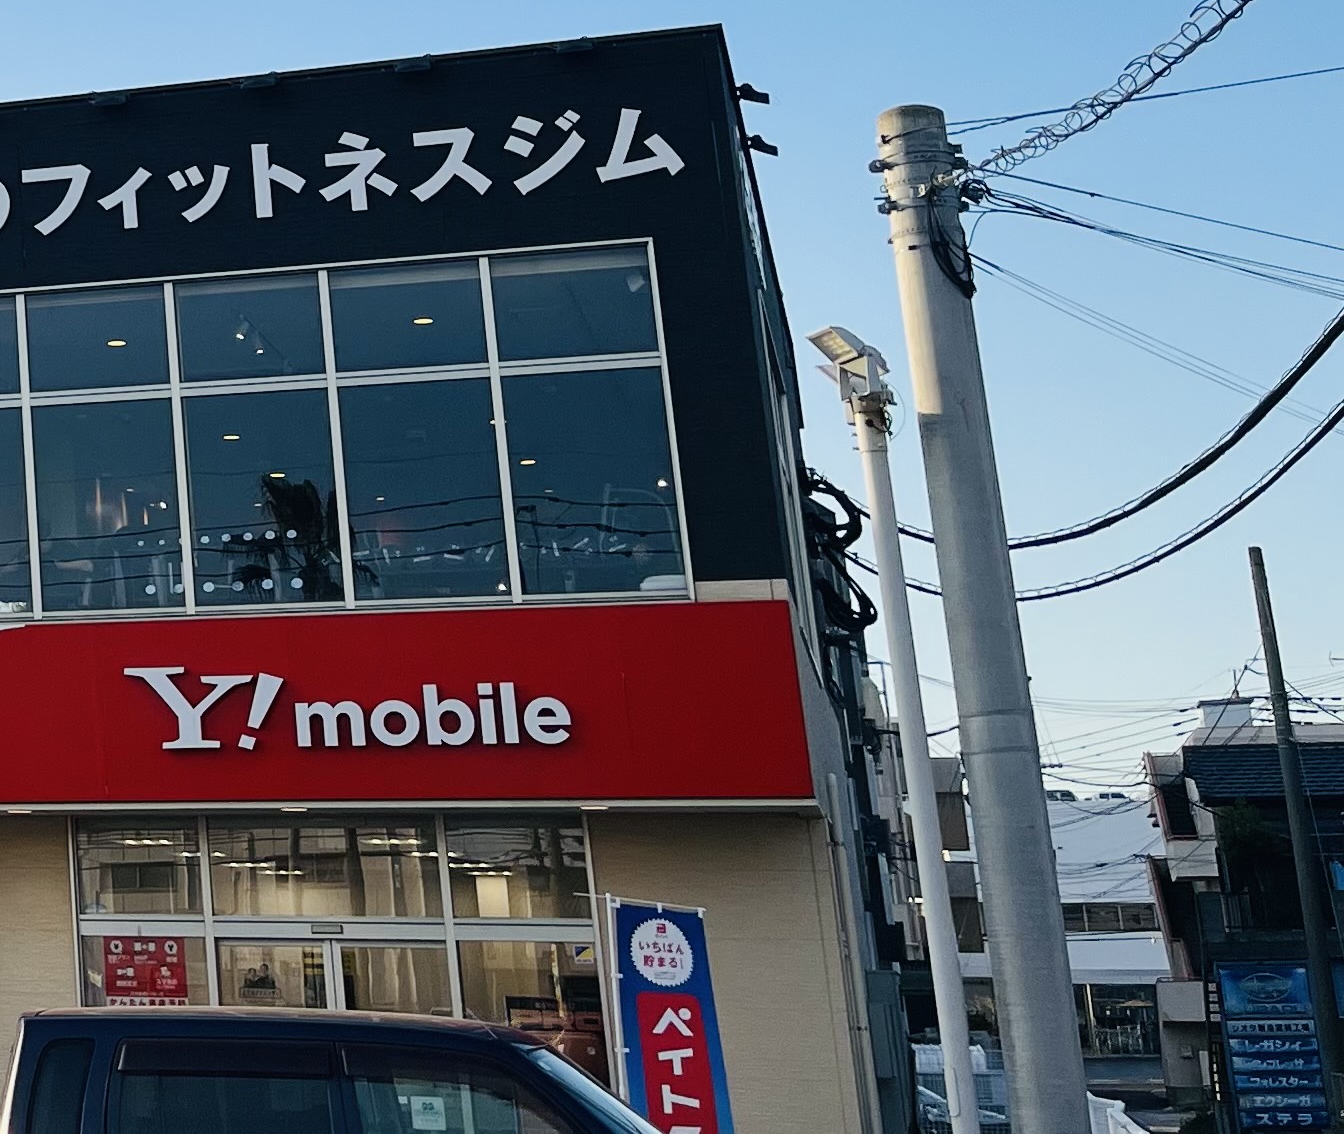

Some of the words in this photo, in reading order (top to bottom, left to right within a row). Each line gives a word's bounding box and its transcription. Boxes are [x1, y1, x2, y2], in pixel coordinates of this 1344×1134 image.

[124, 666, 284, 750] Y!
[295, 682, 572, 747] mobile
[638, 941, 684, 955] いちばん
[652, 1006, 702, 1134] ペイト
[1255, 1113, 1313, 1126] ステラ
